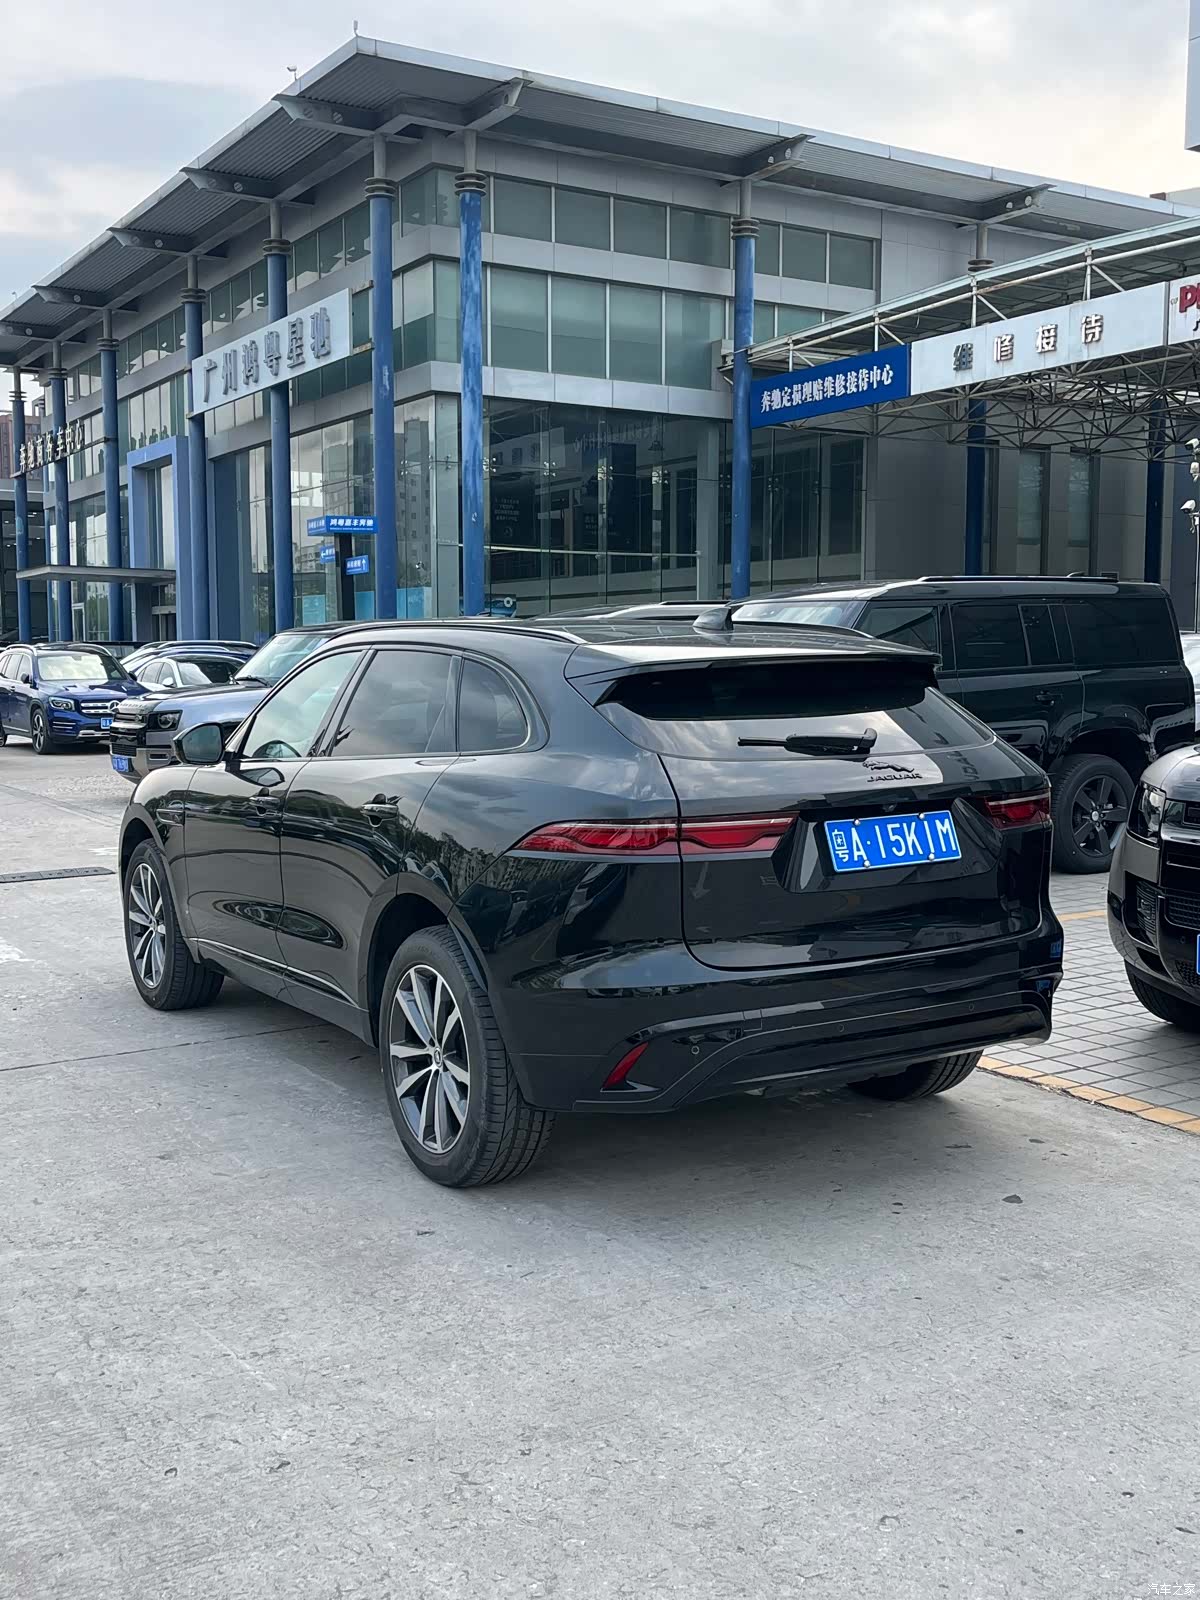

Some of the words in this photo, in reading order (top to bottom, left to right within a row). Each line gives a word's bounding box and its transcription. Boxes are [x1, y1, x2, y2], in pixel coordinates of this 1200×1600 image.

[952, 314, 1104, 372] 维修接待
[760, 364, 894, 413] 奔驰定损理赔维修接待中心
[866, 773, 924, 783] JAGUAR
